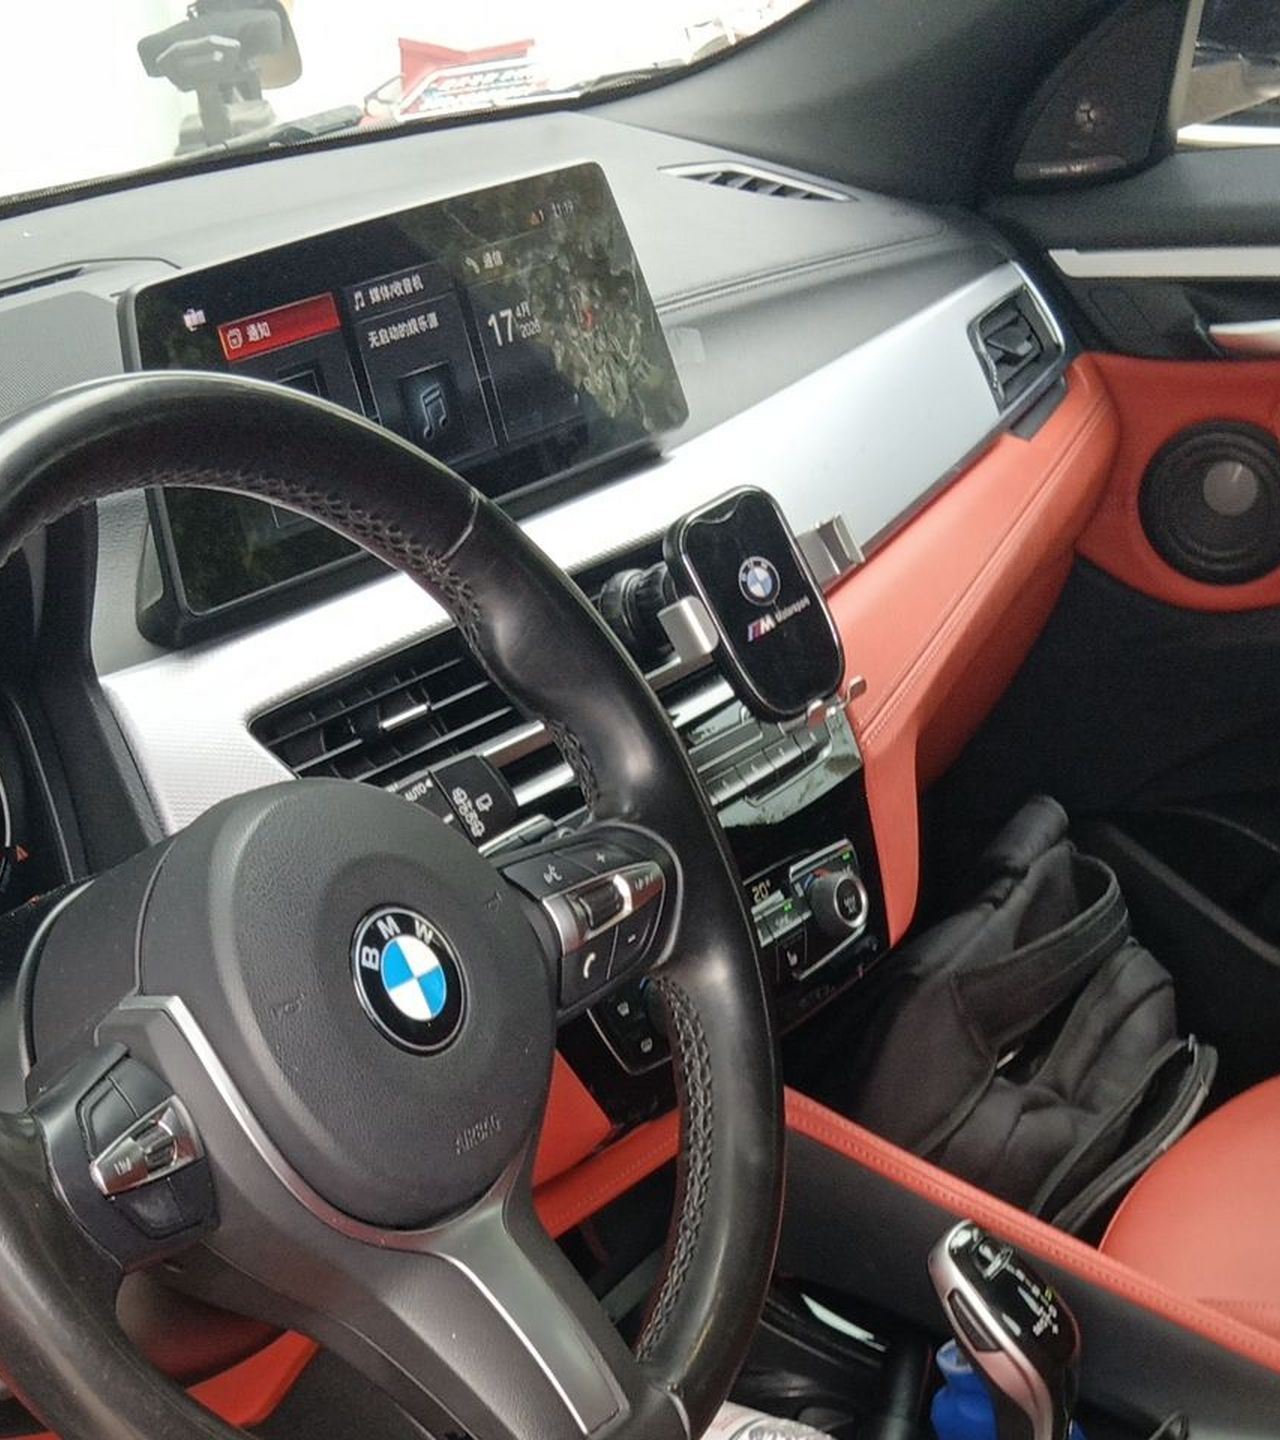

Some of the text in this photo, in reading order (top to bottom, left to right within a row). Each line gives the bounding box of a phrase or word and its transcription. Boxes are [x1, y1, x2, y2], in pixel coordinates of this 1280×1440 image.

[246, 320, 271, 343] 通知
[487, 308, 514, 347] 17
[361, 914, 434, 972] BMW
